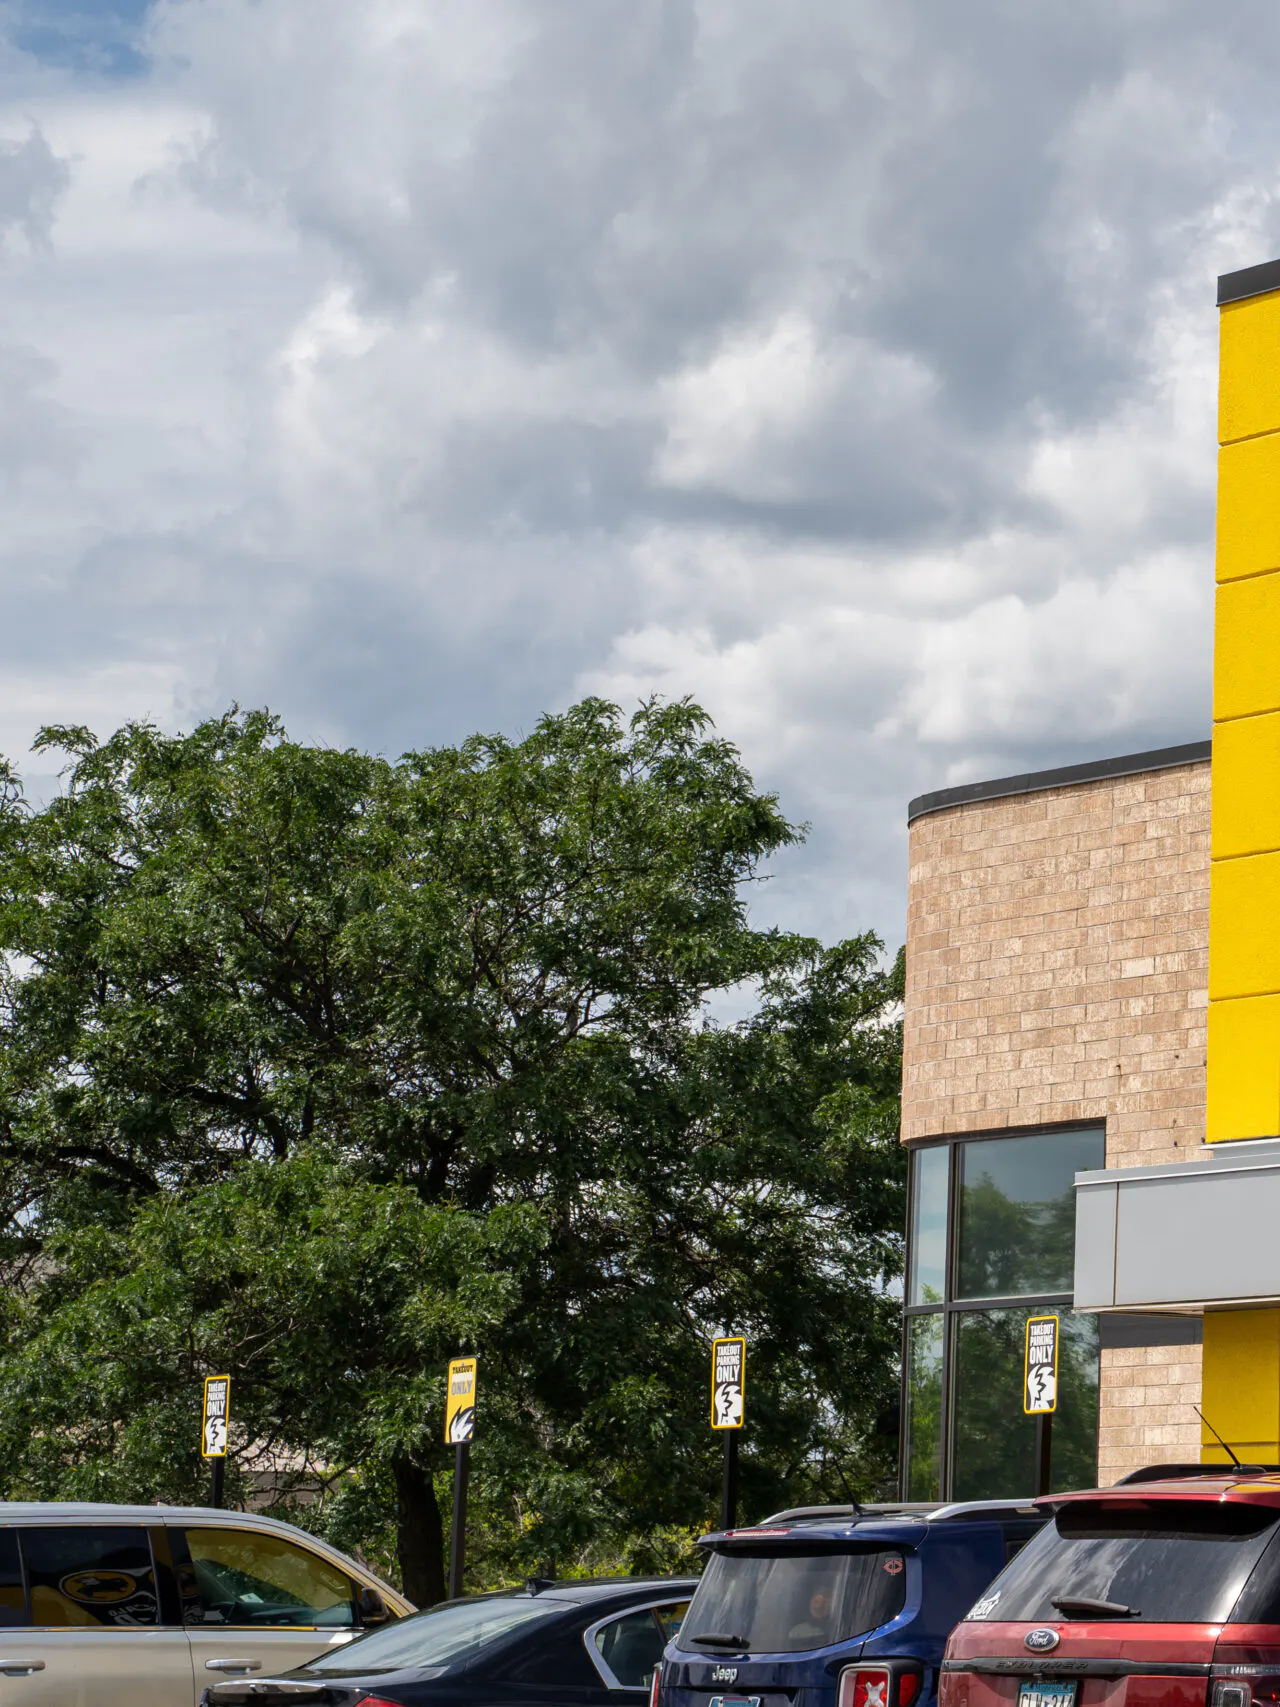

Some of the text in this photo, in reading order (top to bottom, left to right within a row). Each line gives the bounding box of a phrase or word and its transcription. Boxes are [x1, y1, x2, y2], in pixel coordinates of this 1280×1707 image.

[1030, 1335, 1053, 1347] PARKING
[717, 1355, 740, 1366] PARKING
[1029, 1345, 1054, 1365] ONLY
[716, 1364, 740, 1383] ONLY
[451, 1380, 472, 1396] ONLY
[207, 1400, 226, 1417] ONLY
[1029, 1630, 1050, 1646] Ford
[712, 1665, 738, 1684] Jeep
